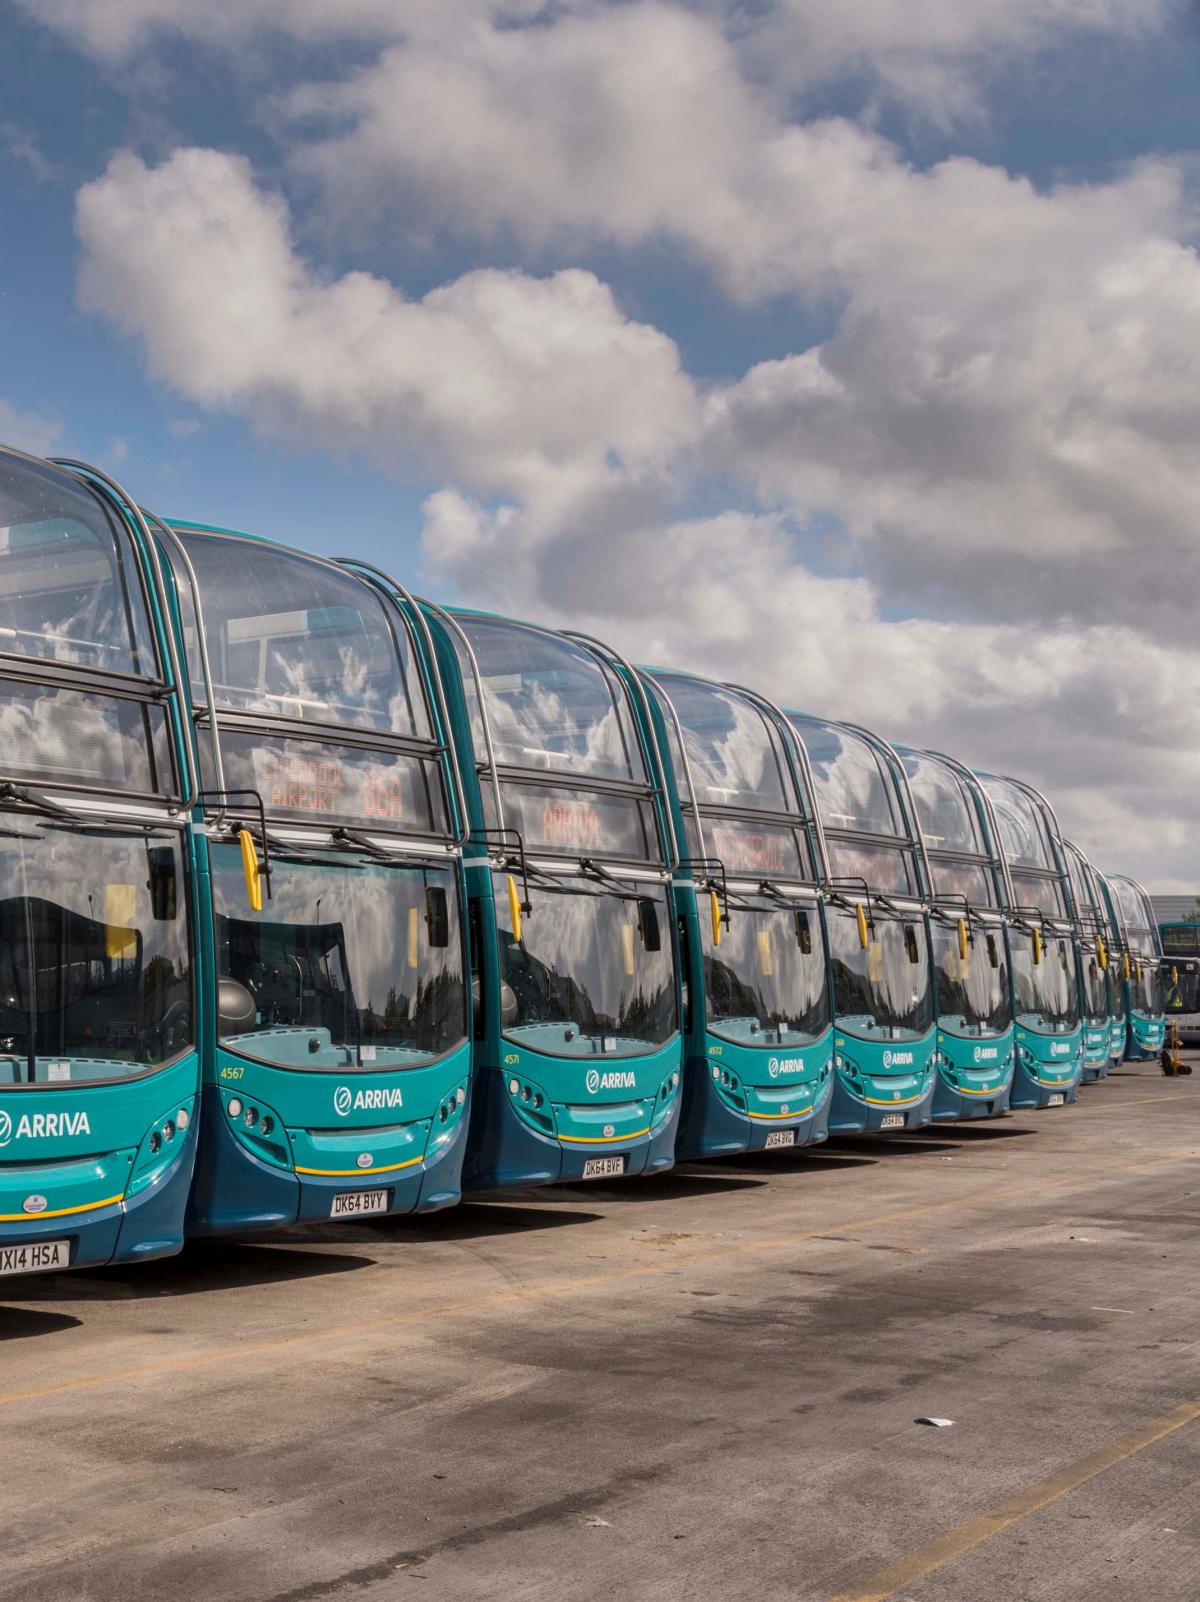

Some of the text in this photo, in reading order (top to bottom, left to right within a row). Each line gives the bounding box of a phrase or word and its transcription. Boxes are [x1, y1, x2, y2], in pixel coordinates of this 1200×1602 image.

[271, 782, 338, 812] AIRPORT
[504, 1054, 520, 1065] 4571
[779, 1059, 804, 1073] ARRIVA
[891, 1052, 913, 1065] ARRIVA
[220, 1067, 245, 1079] 4567
[600, 1071, 636, 1088] ARRIVA
[353, 1088, 403, 1109] ARRIVA
[15, 1111, 91, 1138] ARRIVA
[586, 1158, 621, 1175] DK64 BVF
[335, 1192, 383, 1212] DK64 BVY
[31, 1244, 59, 1267] HSA
